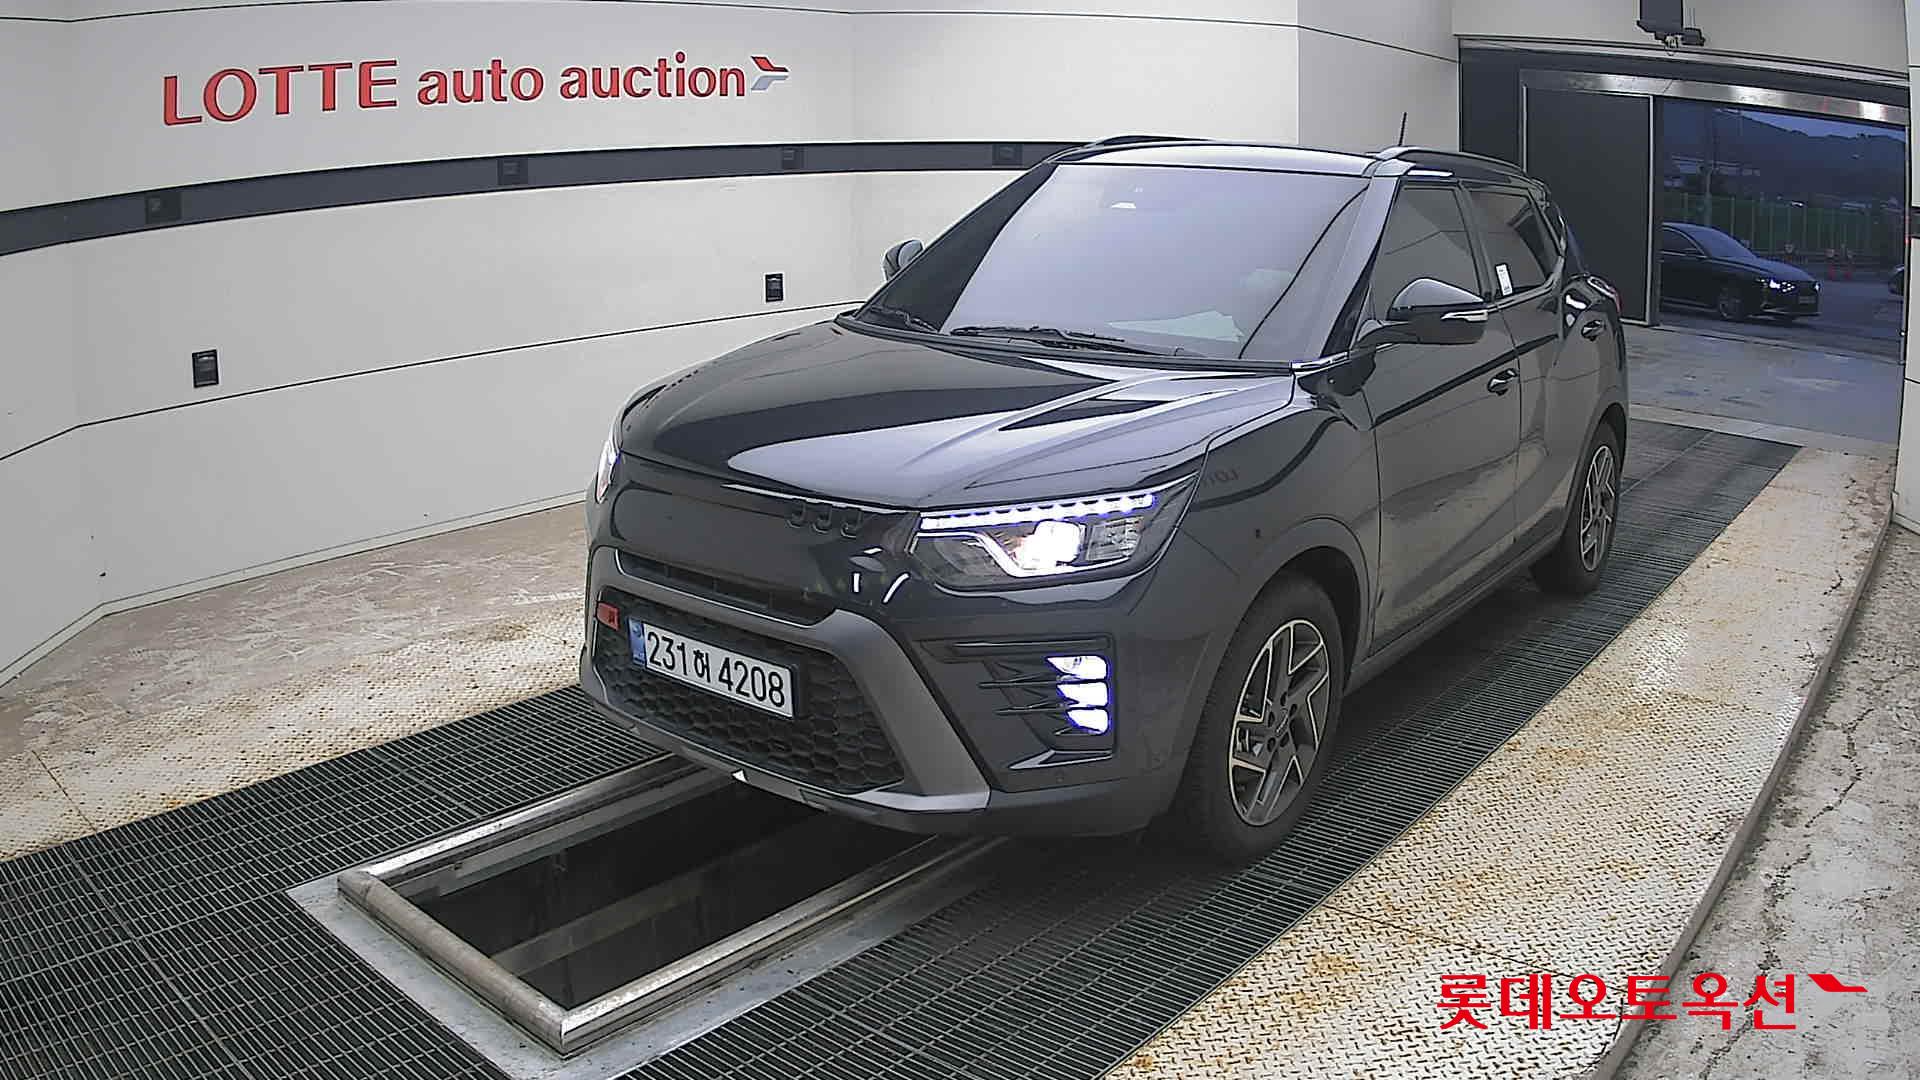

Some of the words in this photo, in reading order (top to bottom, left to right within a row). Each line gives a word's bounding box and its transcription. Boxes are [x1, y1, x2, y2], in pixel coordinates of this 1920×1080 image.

[163, 59, 398, 126] LOTTE
[417, 58, 544, 105] auto
[560, 51, 746, 98] auction
[718, 656, 785, 708] 4208
